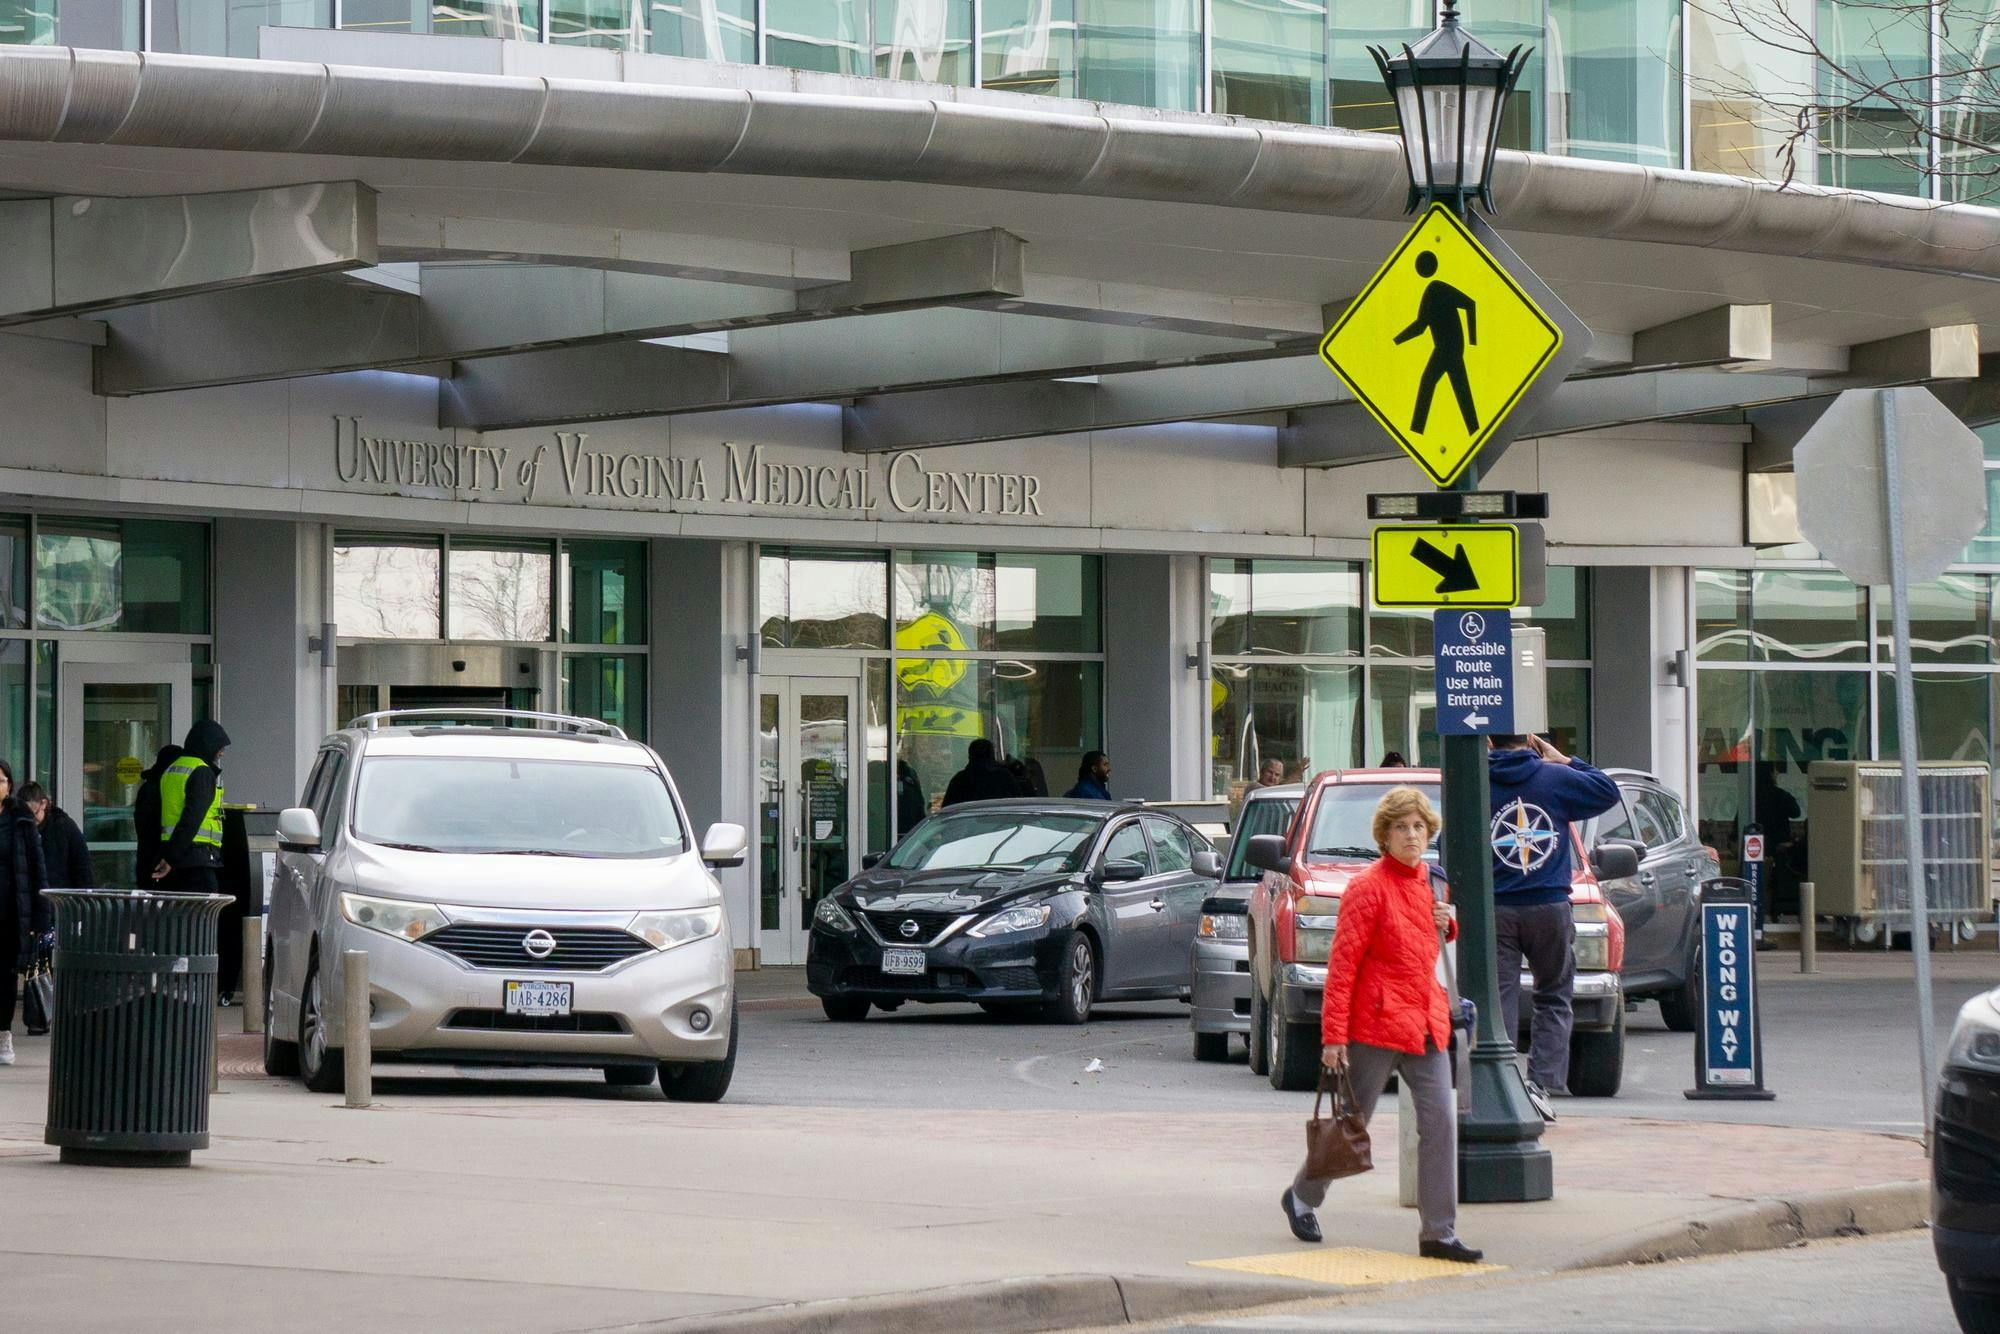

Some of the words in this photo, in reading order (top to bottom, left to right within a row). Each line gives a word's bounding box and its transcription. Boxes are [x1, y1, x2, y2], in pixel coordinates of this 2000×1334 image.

[518, 444, 549, 502] of
[1441, 642, 1506, 656] Accessible
[1455, 660, 1492, 673] Route
[1446, 677, 1469, 689] Use
[1473, 675, 1503, 689] Main
[1447, 693, 1503, 706] Entrance
[1716, 914, 1738, 1001] WRONG
[510, 990, 568, 1007] UAB-4286
[1717, 1010, 1740, 1062] WAY
